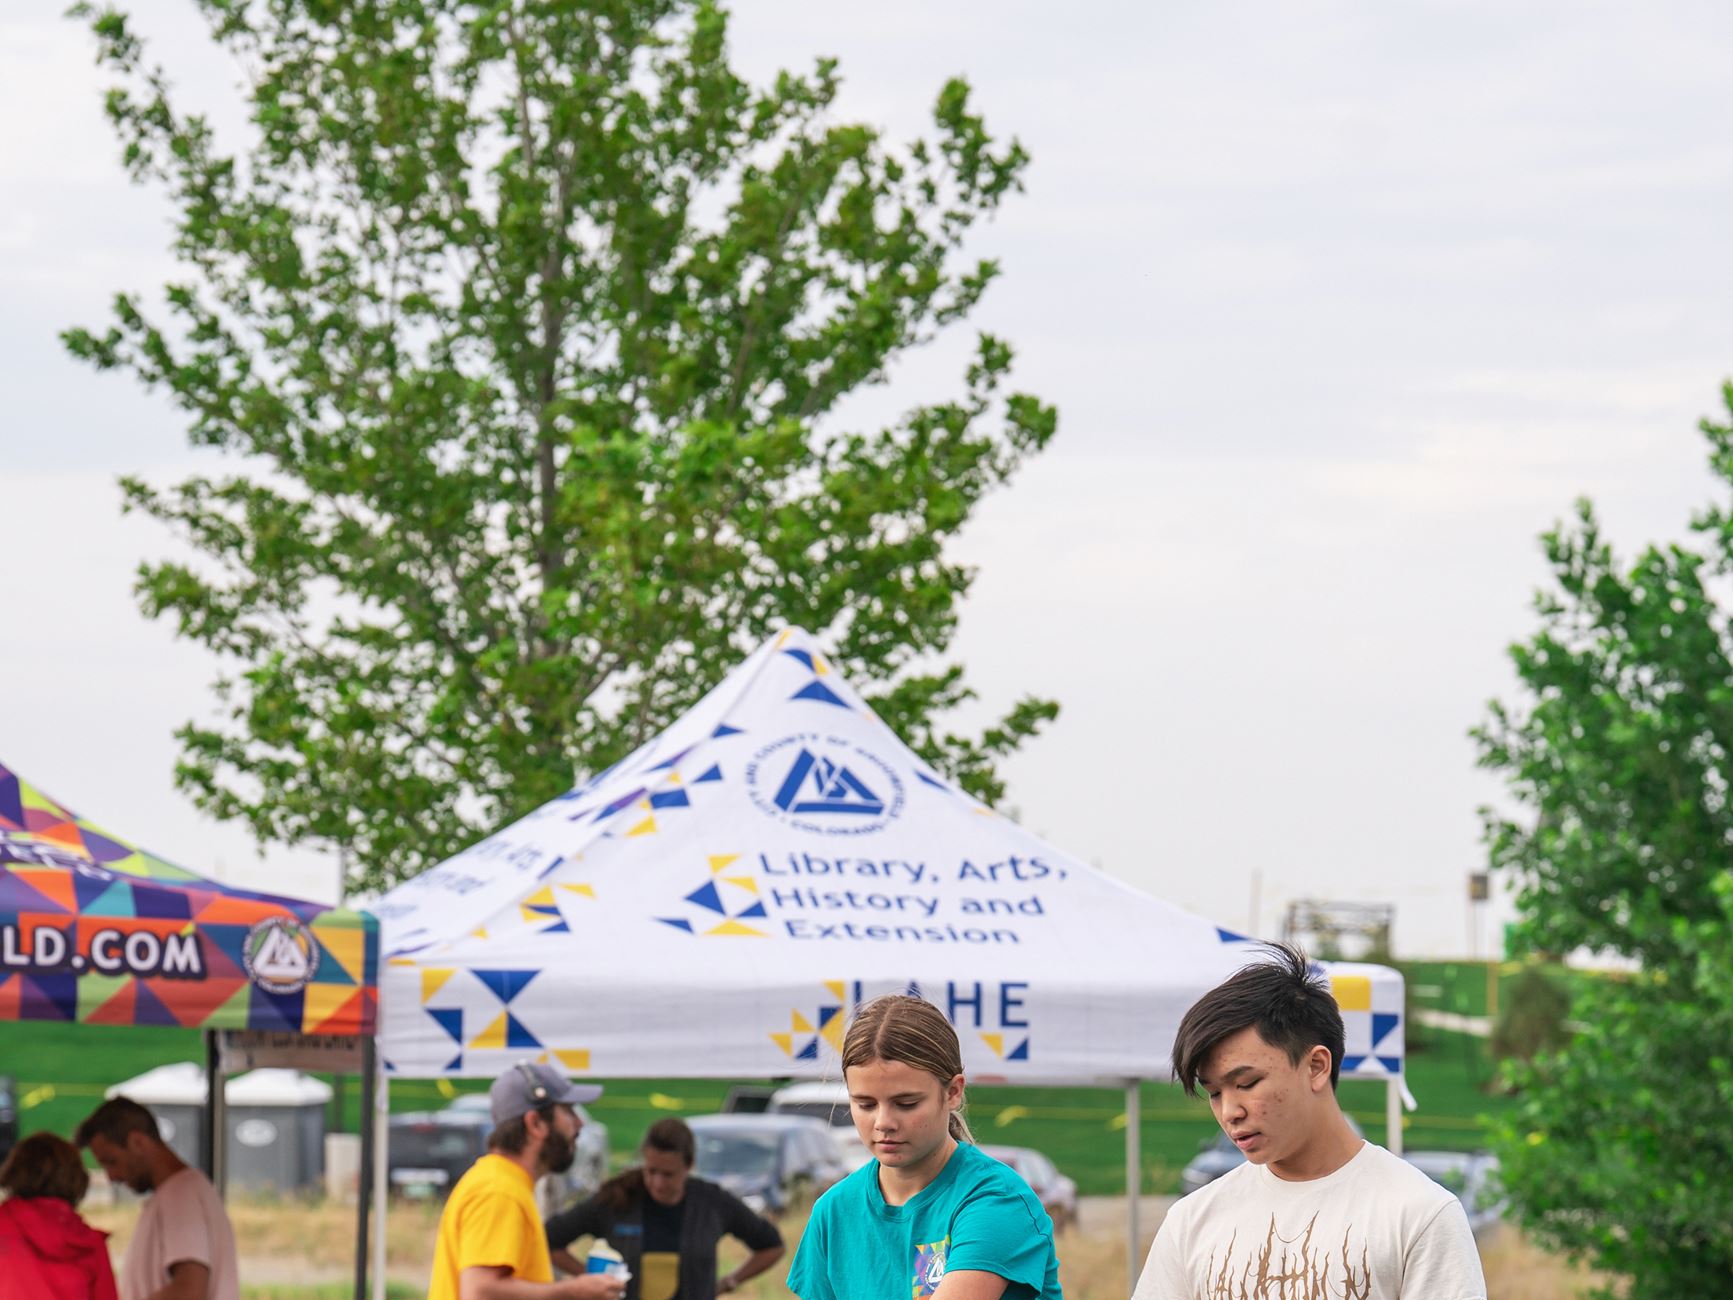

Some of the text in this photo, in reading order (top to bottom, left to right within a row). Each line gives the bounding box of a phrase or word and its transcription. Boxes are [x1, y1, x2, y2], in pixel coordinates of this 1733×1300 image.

[759, 852, 1068, 883] Library, Arts,
[771, 887, 1045, 916] History and
[784, 919, 1020, 944] Extension
